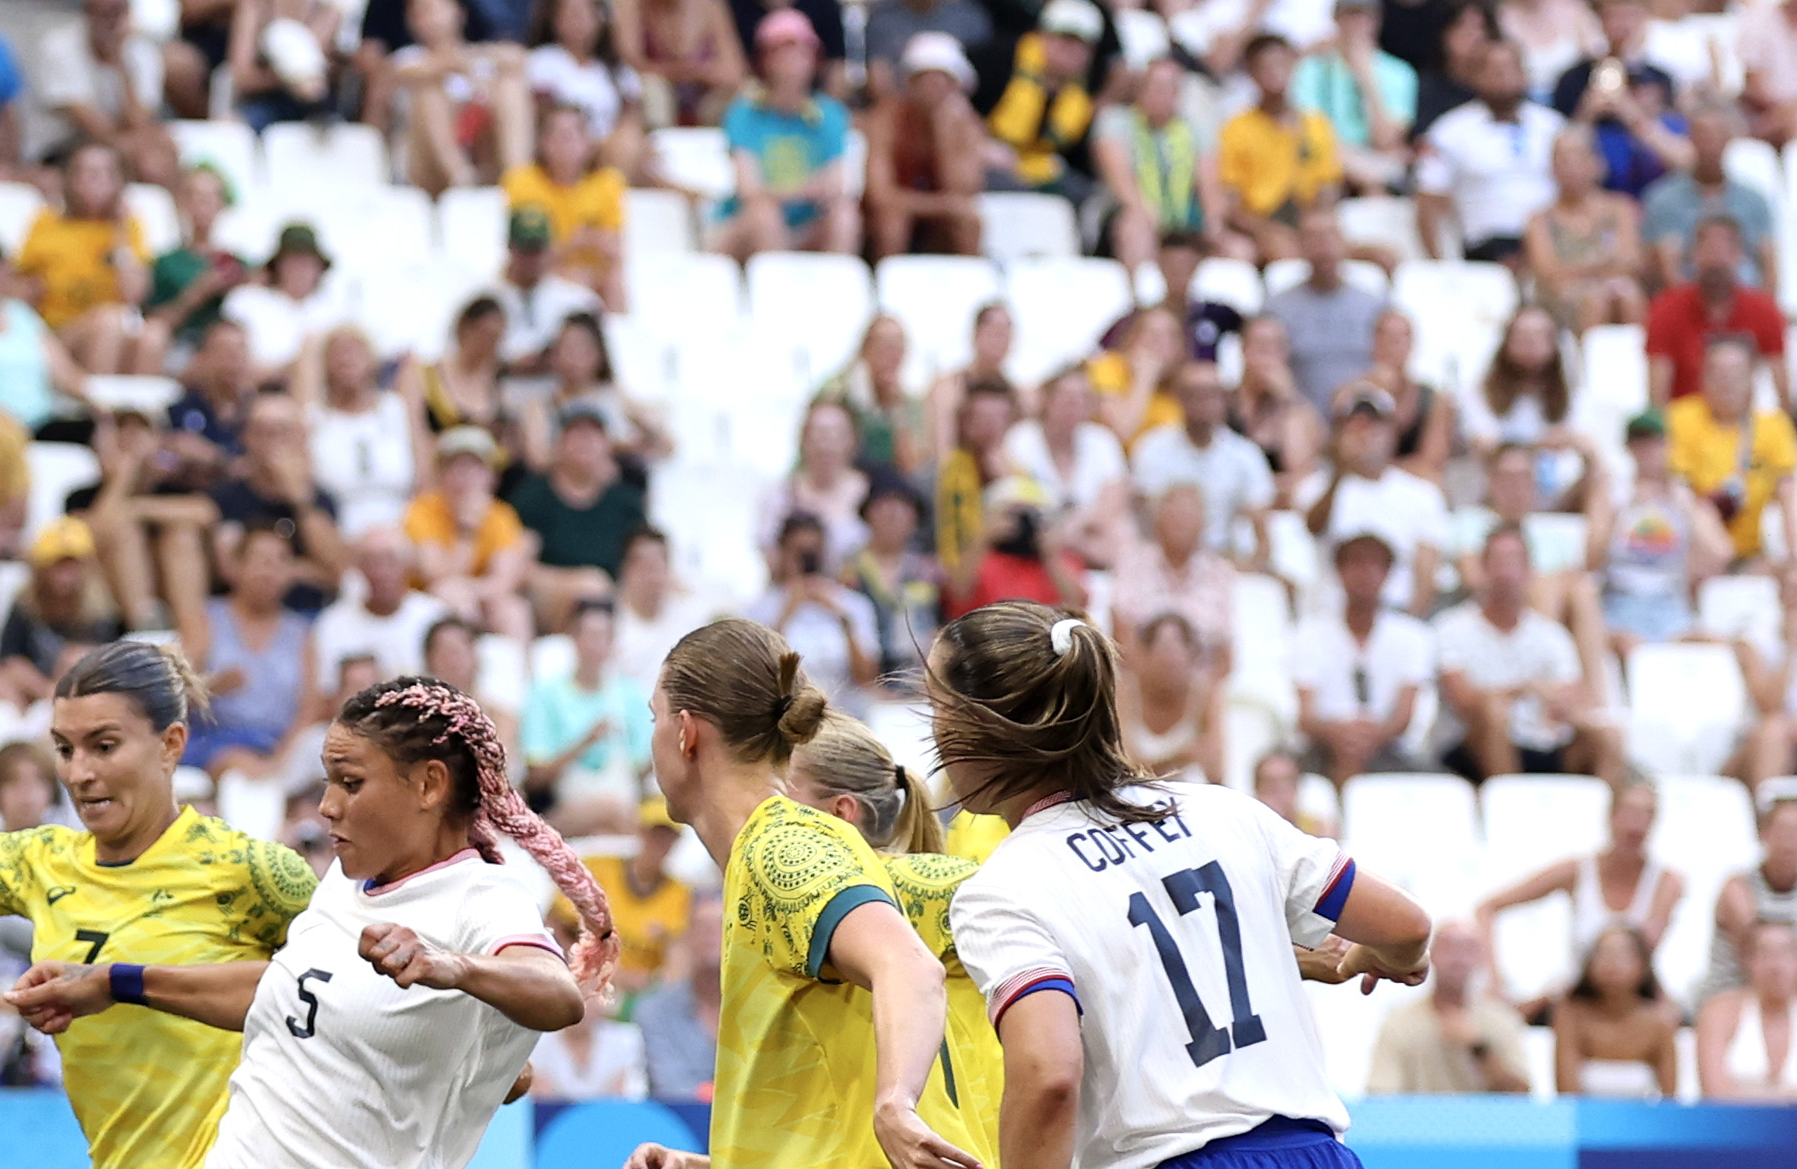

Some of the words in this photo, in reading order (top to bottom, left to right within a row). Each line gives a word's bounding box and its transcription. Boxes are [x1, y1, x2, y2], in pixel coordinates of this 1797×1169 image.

[75, 929, 110, 963] 7
[1127, 860, 1267, 1068] 17
[286, 967, 334, 1039] 5
